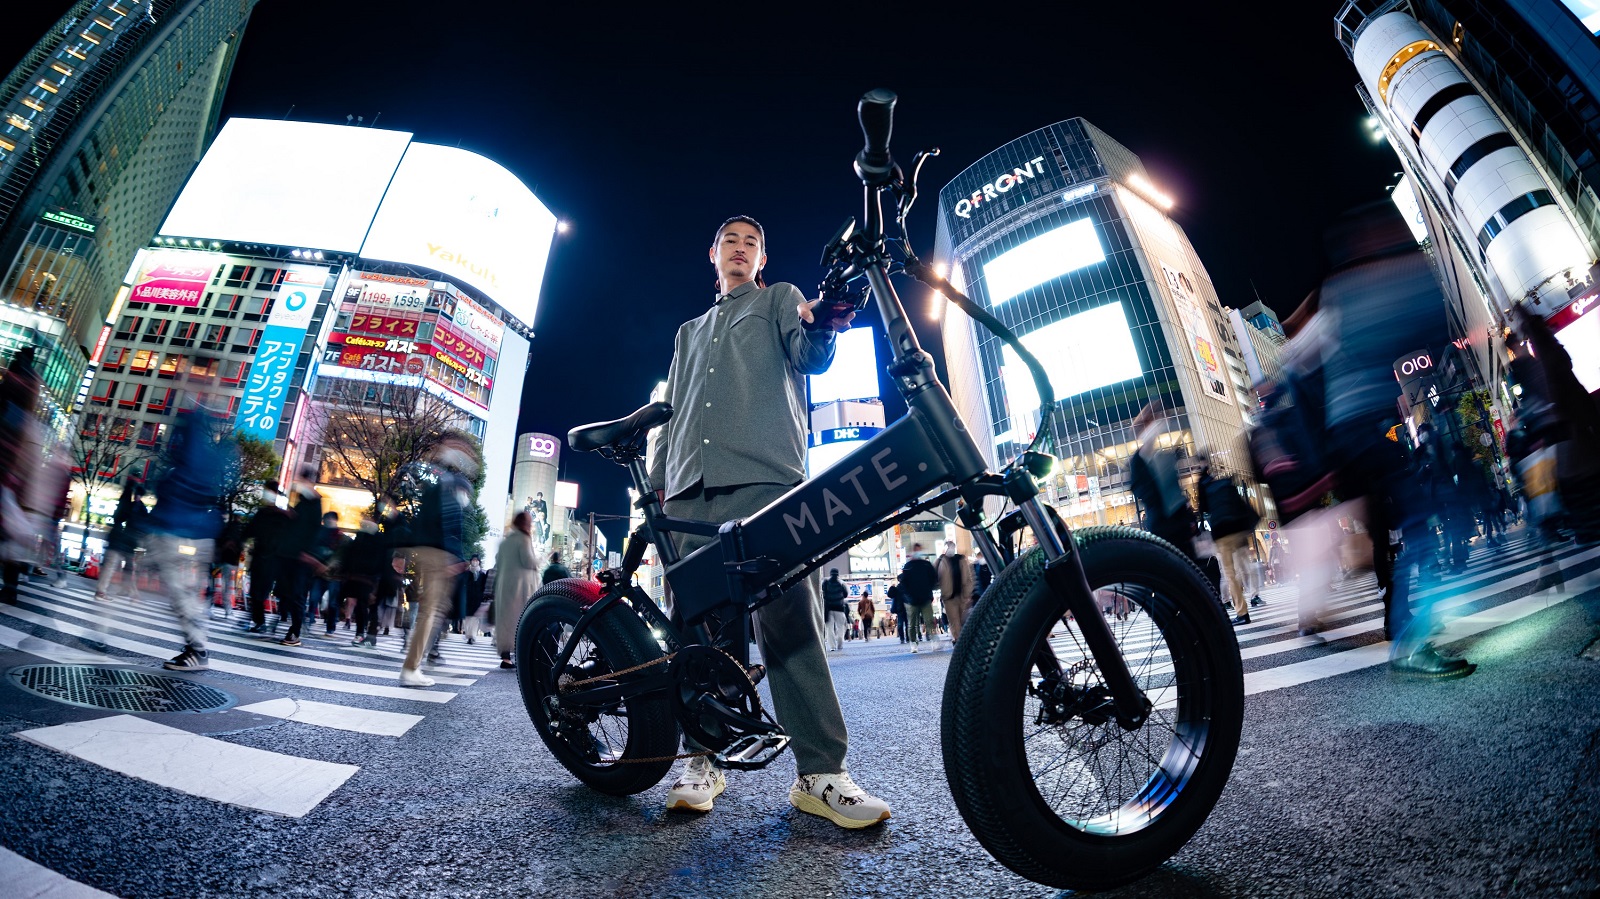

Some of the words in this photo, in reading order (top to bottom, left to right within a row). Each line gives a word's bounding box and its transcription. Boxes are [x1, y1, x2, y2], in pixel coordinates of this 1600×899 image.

[955, 155, 1044, 219] QFRONT
[427, 242, 498, 288] Yakult
[141, 286, 199, 302] 品川美容外科
[346, 287, 360, 297] 9F
[352, 315, 415, 334] プライス
[384, 339, 419, 354] ガスト
[434, 326, 483, 364] コンタクト
[325, 350, 342, 361] 7F
[360, 353, 401, 372] ガスト
[243, 340, 282, 428] アイシティ
[259, 342, 297, 430] コンタクトの
[465, 367, 489, 387] ガスト
[833, 428, 860, 440] DHC
[530, 436, 556, 458] 109
